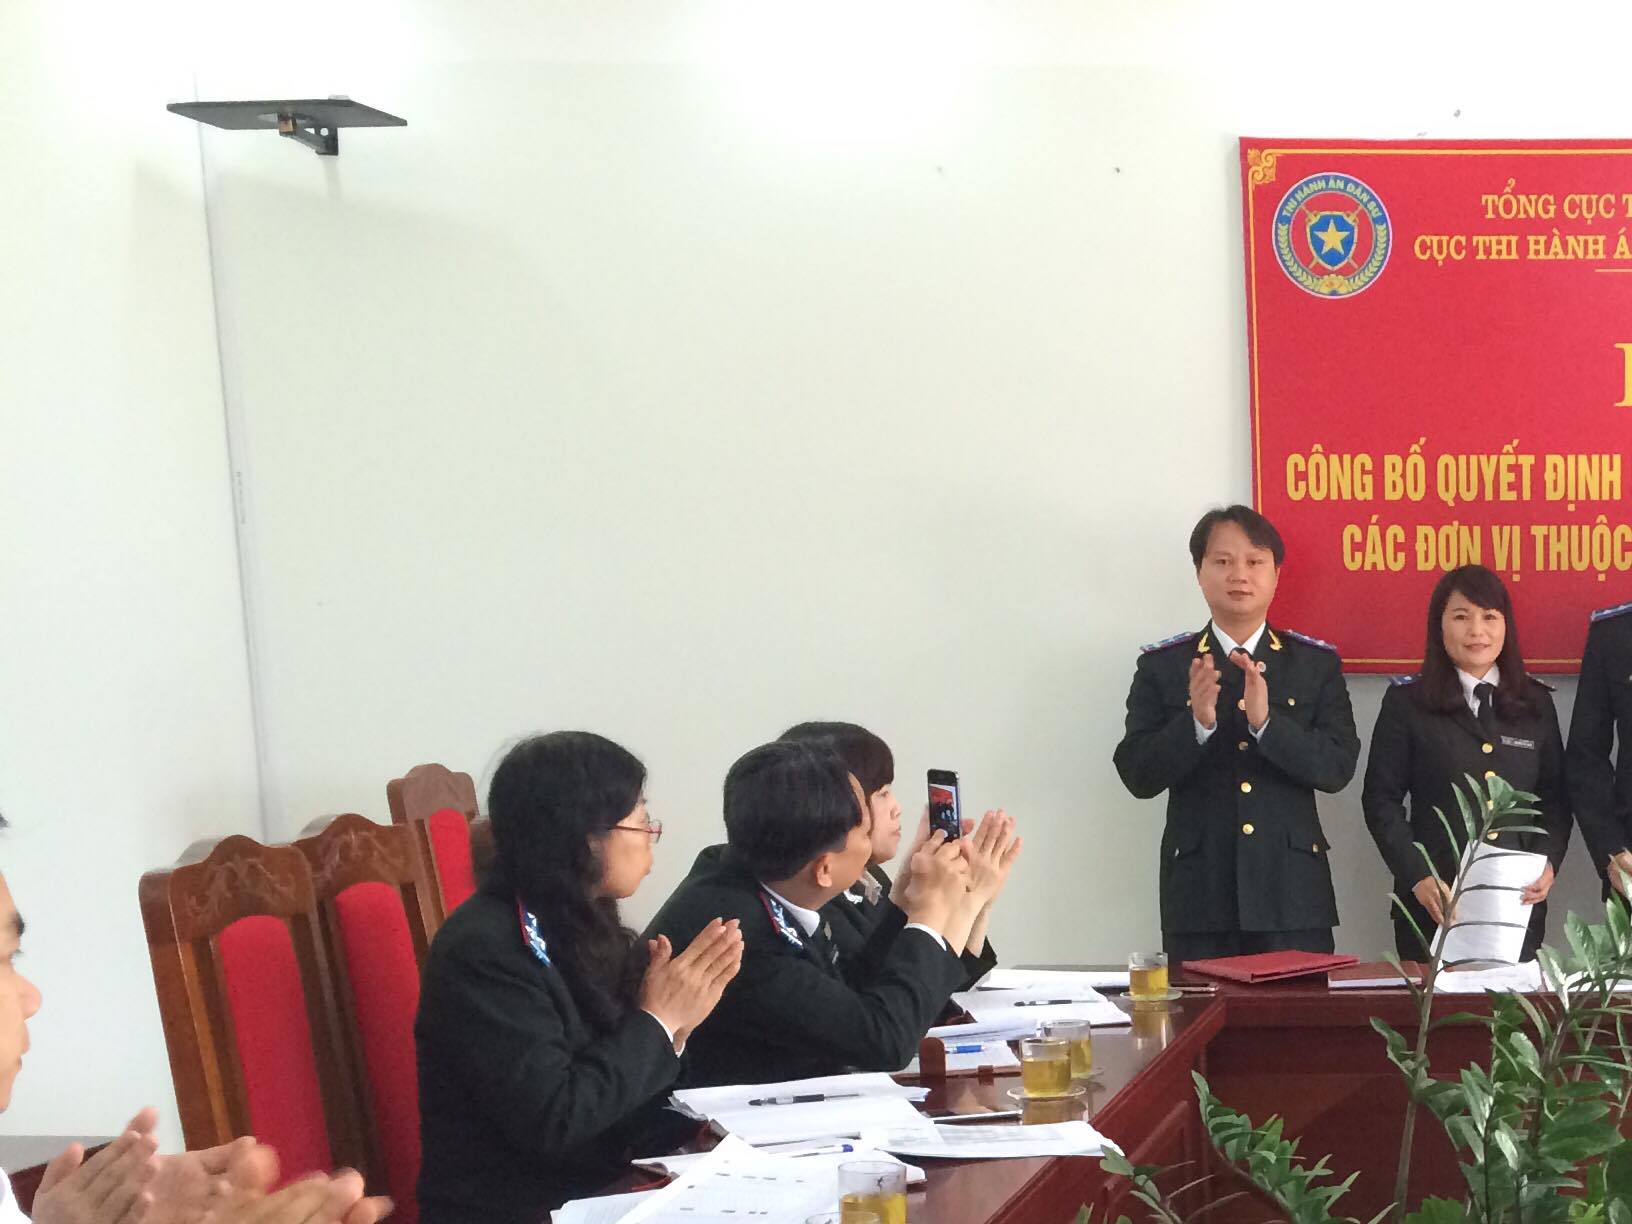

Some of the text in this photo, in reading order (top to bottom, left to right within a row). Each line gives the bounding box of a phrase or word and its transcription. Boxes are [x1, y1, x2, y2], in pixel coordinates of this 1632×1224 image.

[1481, 177, 1557, 220] TỔNG
[1563, 193, 1616, 225] CỤC
[1413, 234, 1466, 267] CỤC
[1472, 235, 1519, 260] THI
[1527, 227, 1606, 260] HÀNH
[1286, 443, 1374, 501] CÔNG
[1383, 437, 1426, 502] BỐ
[1436, 439, 1536, 507] QUYẾT
[1543, 453, 1622, 512] ĐỊNH
[1342, 514, 1406, 572] CÁC
[1415, 521, 1481, 572] ĐƠN
[1491, 525, 1521, 582] VỊ
[1530, 514, 1632, 582] THUỘC
